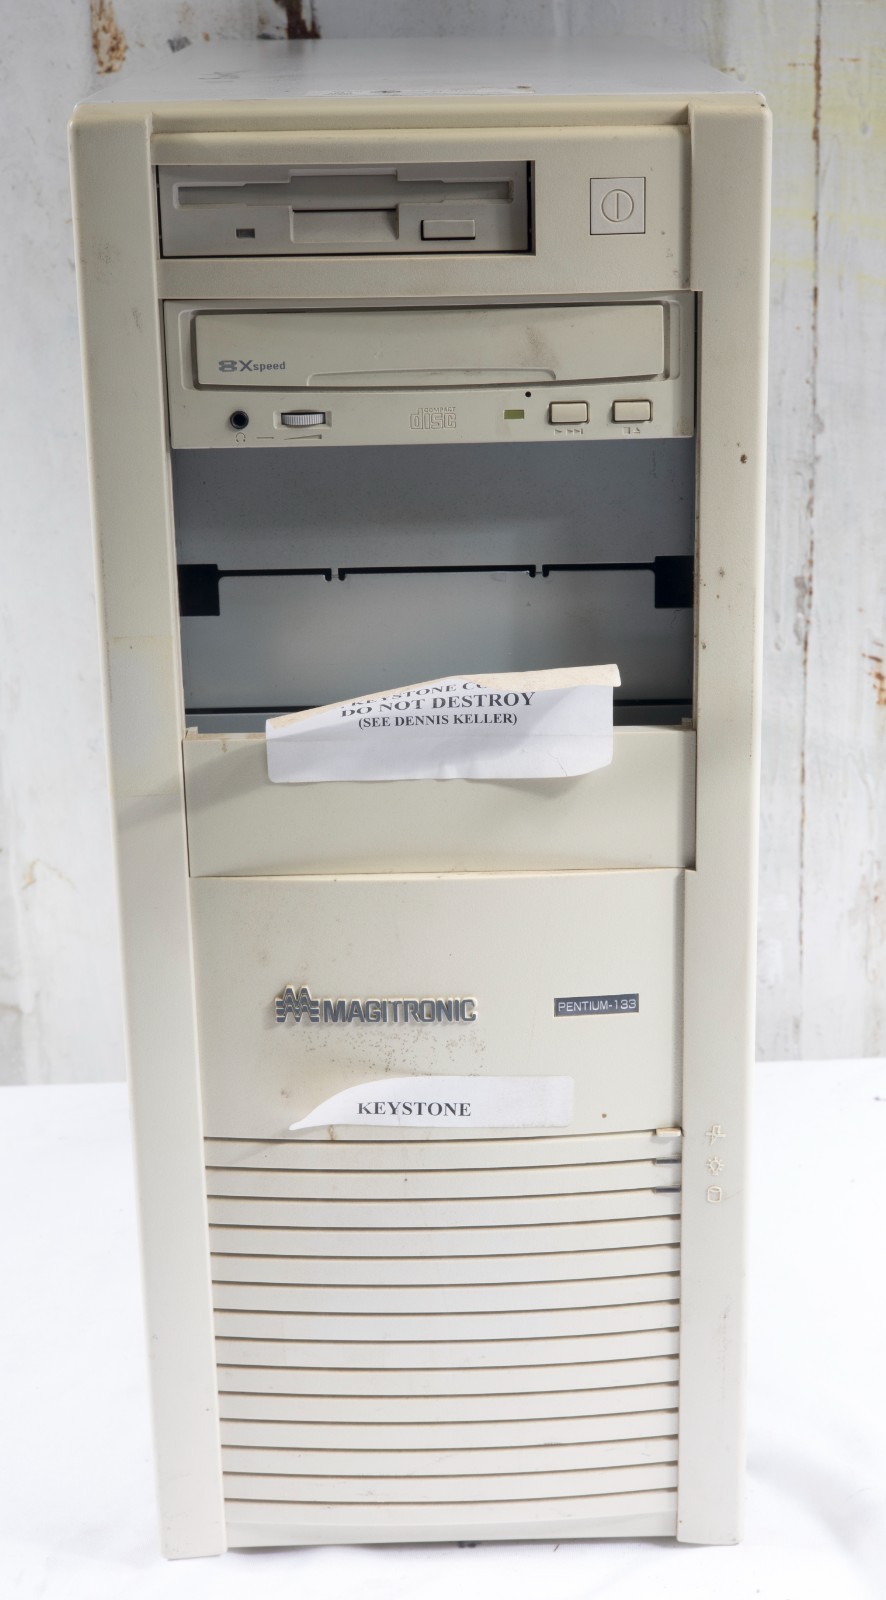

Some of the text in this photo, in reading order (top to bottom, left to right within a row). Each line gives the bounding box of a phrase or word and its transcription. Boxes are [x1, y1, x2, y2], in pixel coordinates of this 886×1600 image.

[341, 692, 536, 717] DO NOT DESTROY
[358, 713, 518, 730] (SEE DENNIS KELLER)
[323, 998, 478, 1023] MAGITRONIC
[558, 998, 637, 1012] PENTIUM-133
[357, 1101, 471, 1117] KEYSTONE
